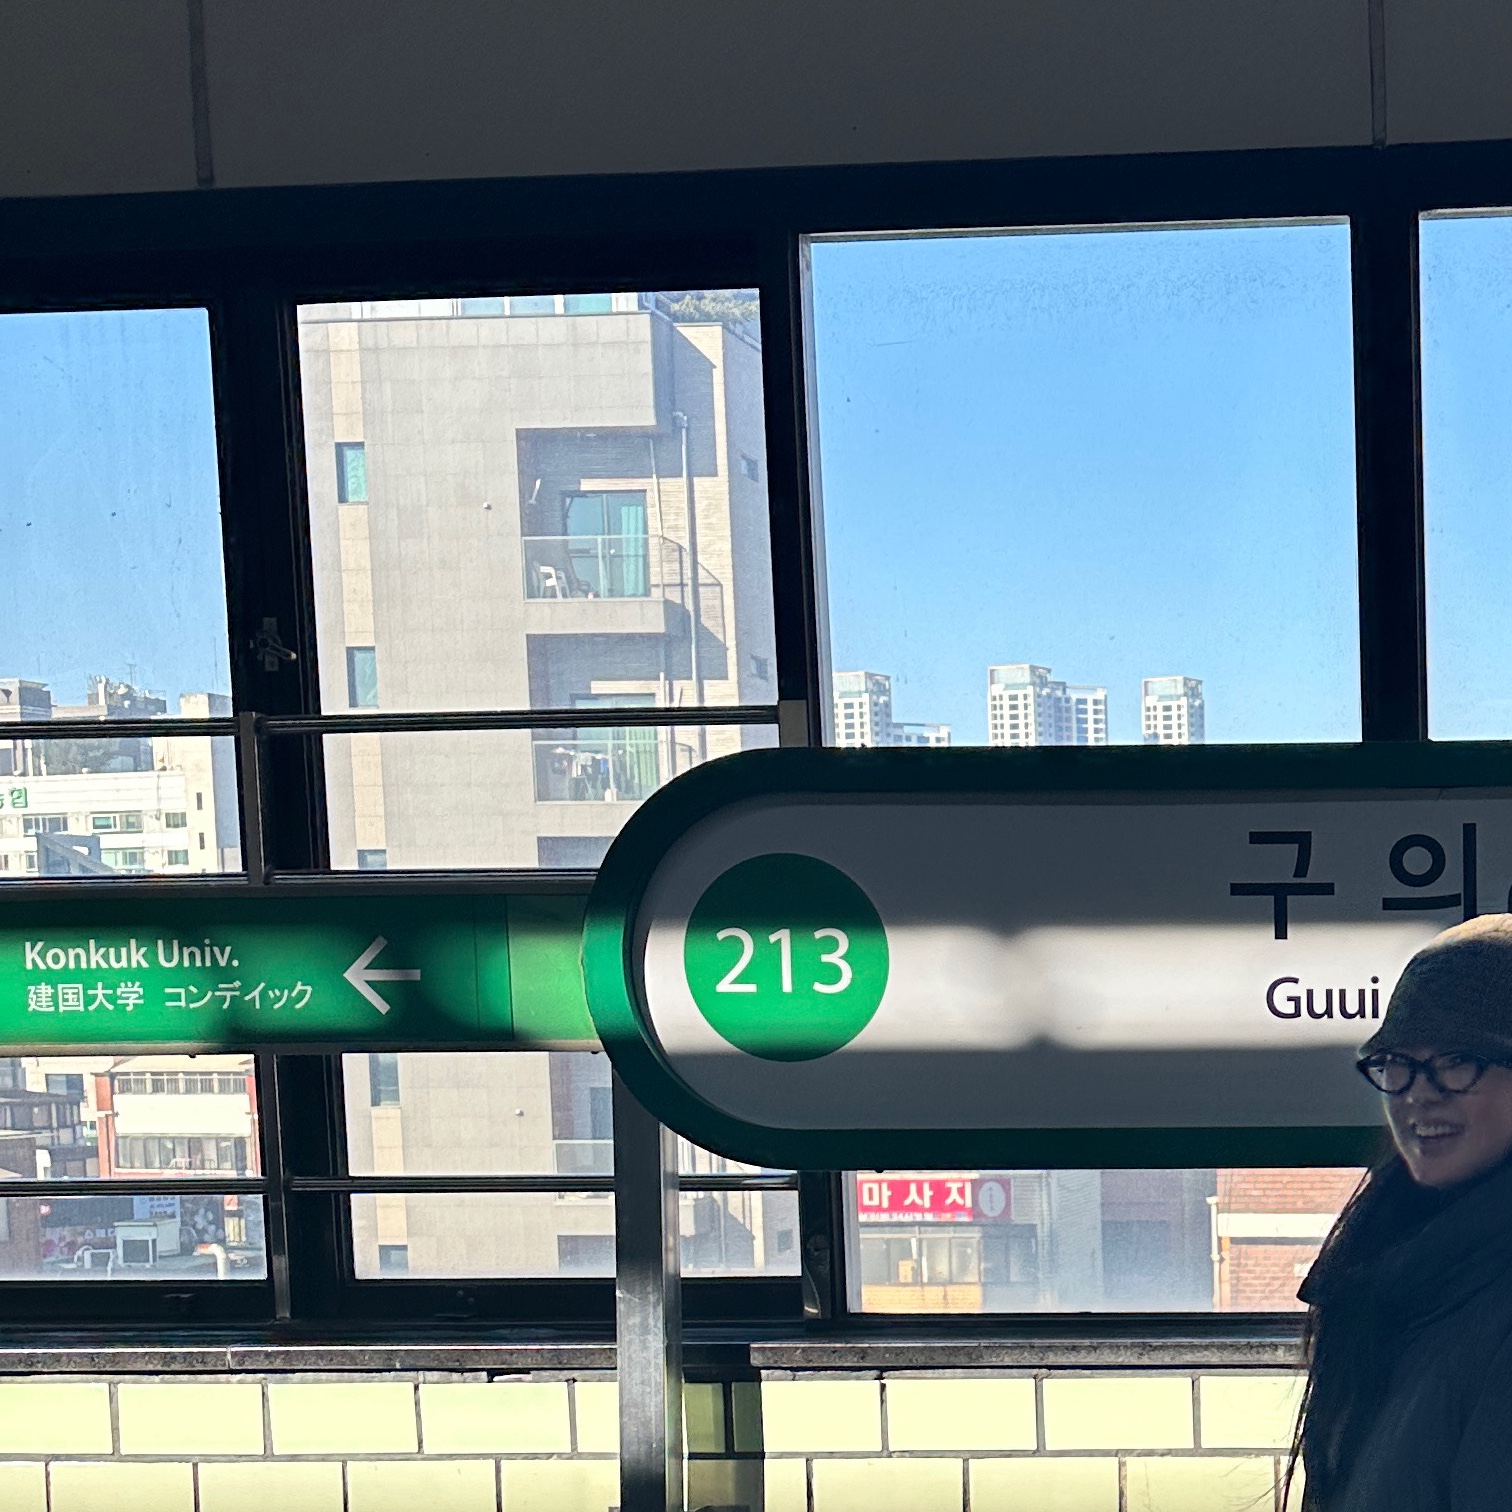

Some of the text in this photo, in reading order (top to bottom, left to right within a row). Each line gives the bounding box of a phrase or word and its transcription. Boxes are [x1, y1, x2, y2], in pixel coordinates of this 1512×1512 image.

[1229, 822, 1478, 940] 구의
[24, 938, 239, 970] Konkuk Univ.
[715, 927, 853, 994] 213
[27, 981, 145, 1012] 建国大学
[1265, 975, 1380, 1019] Guui
[862, 1181, 972, 1209] 마사지
